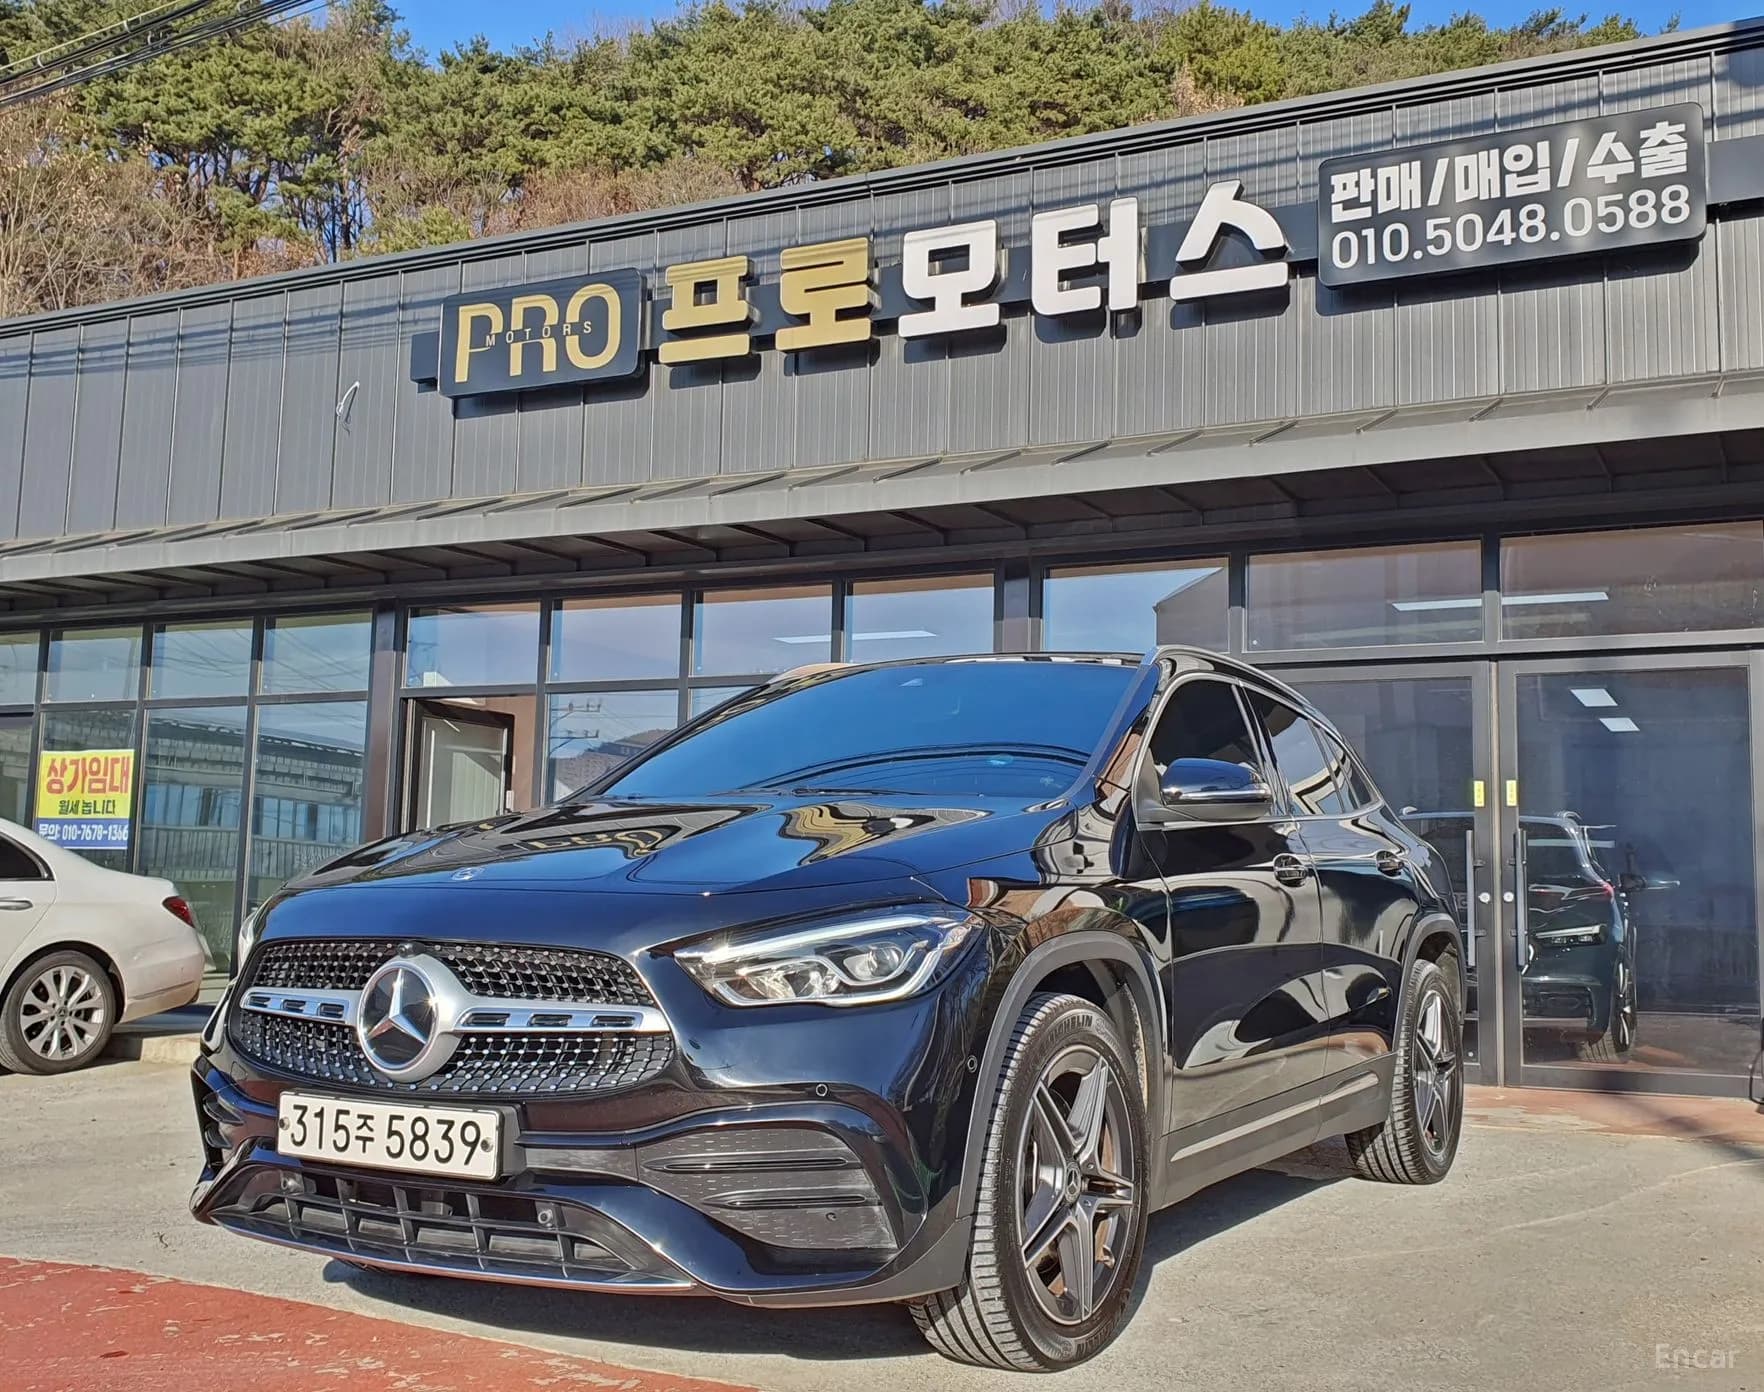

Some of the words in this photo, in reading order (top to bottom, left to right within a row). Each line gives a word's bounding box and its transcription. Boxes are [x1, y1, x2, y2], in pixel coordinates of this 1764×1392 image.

[1330, 121, 1689, 223] 판매/매입/수출
[1331, 184, 1691, 269] 010.5048.0588
[658, 179, 1289, 364] 프로모터스
[455, 283, 621, 383] PRO
[485, 321, 592, 347] MOTORS
[46, 756, 130, 794] 상가임대
[58, 799, 80, 815] 월세
[290, 1104, 375, 1154] 315주
[385, 1114, 481, 1166] 5839
